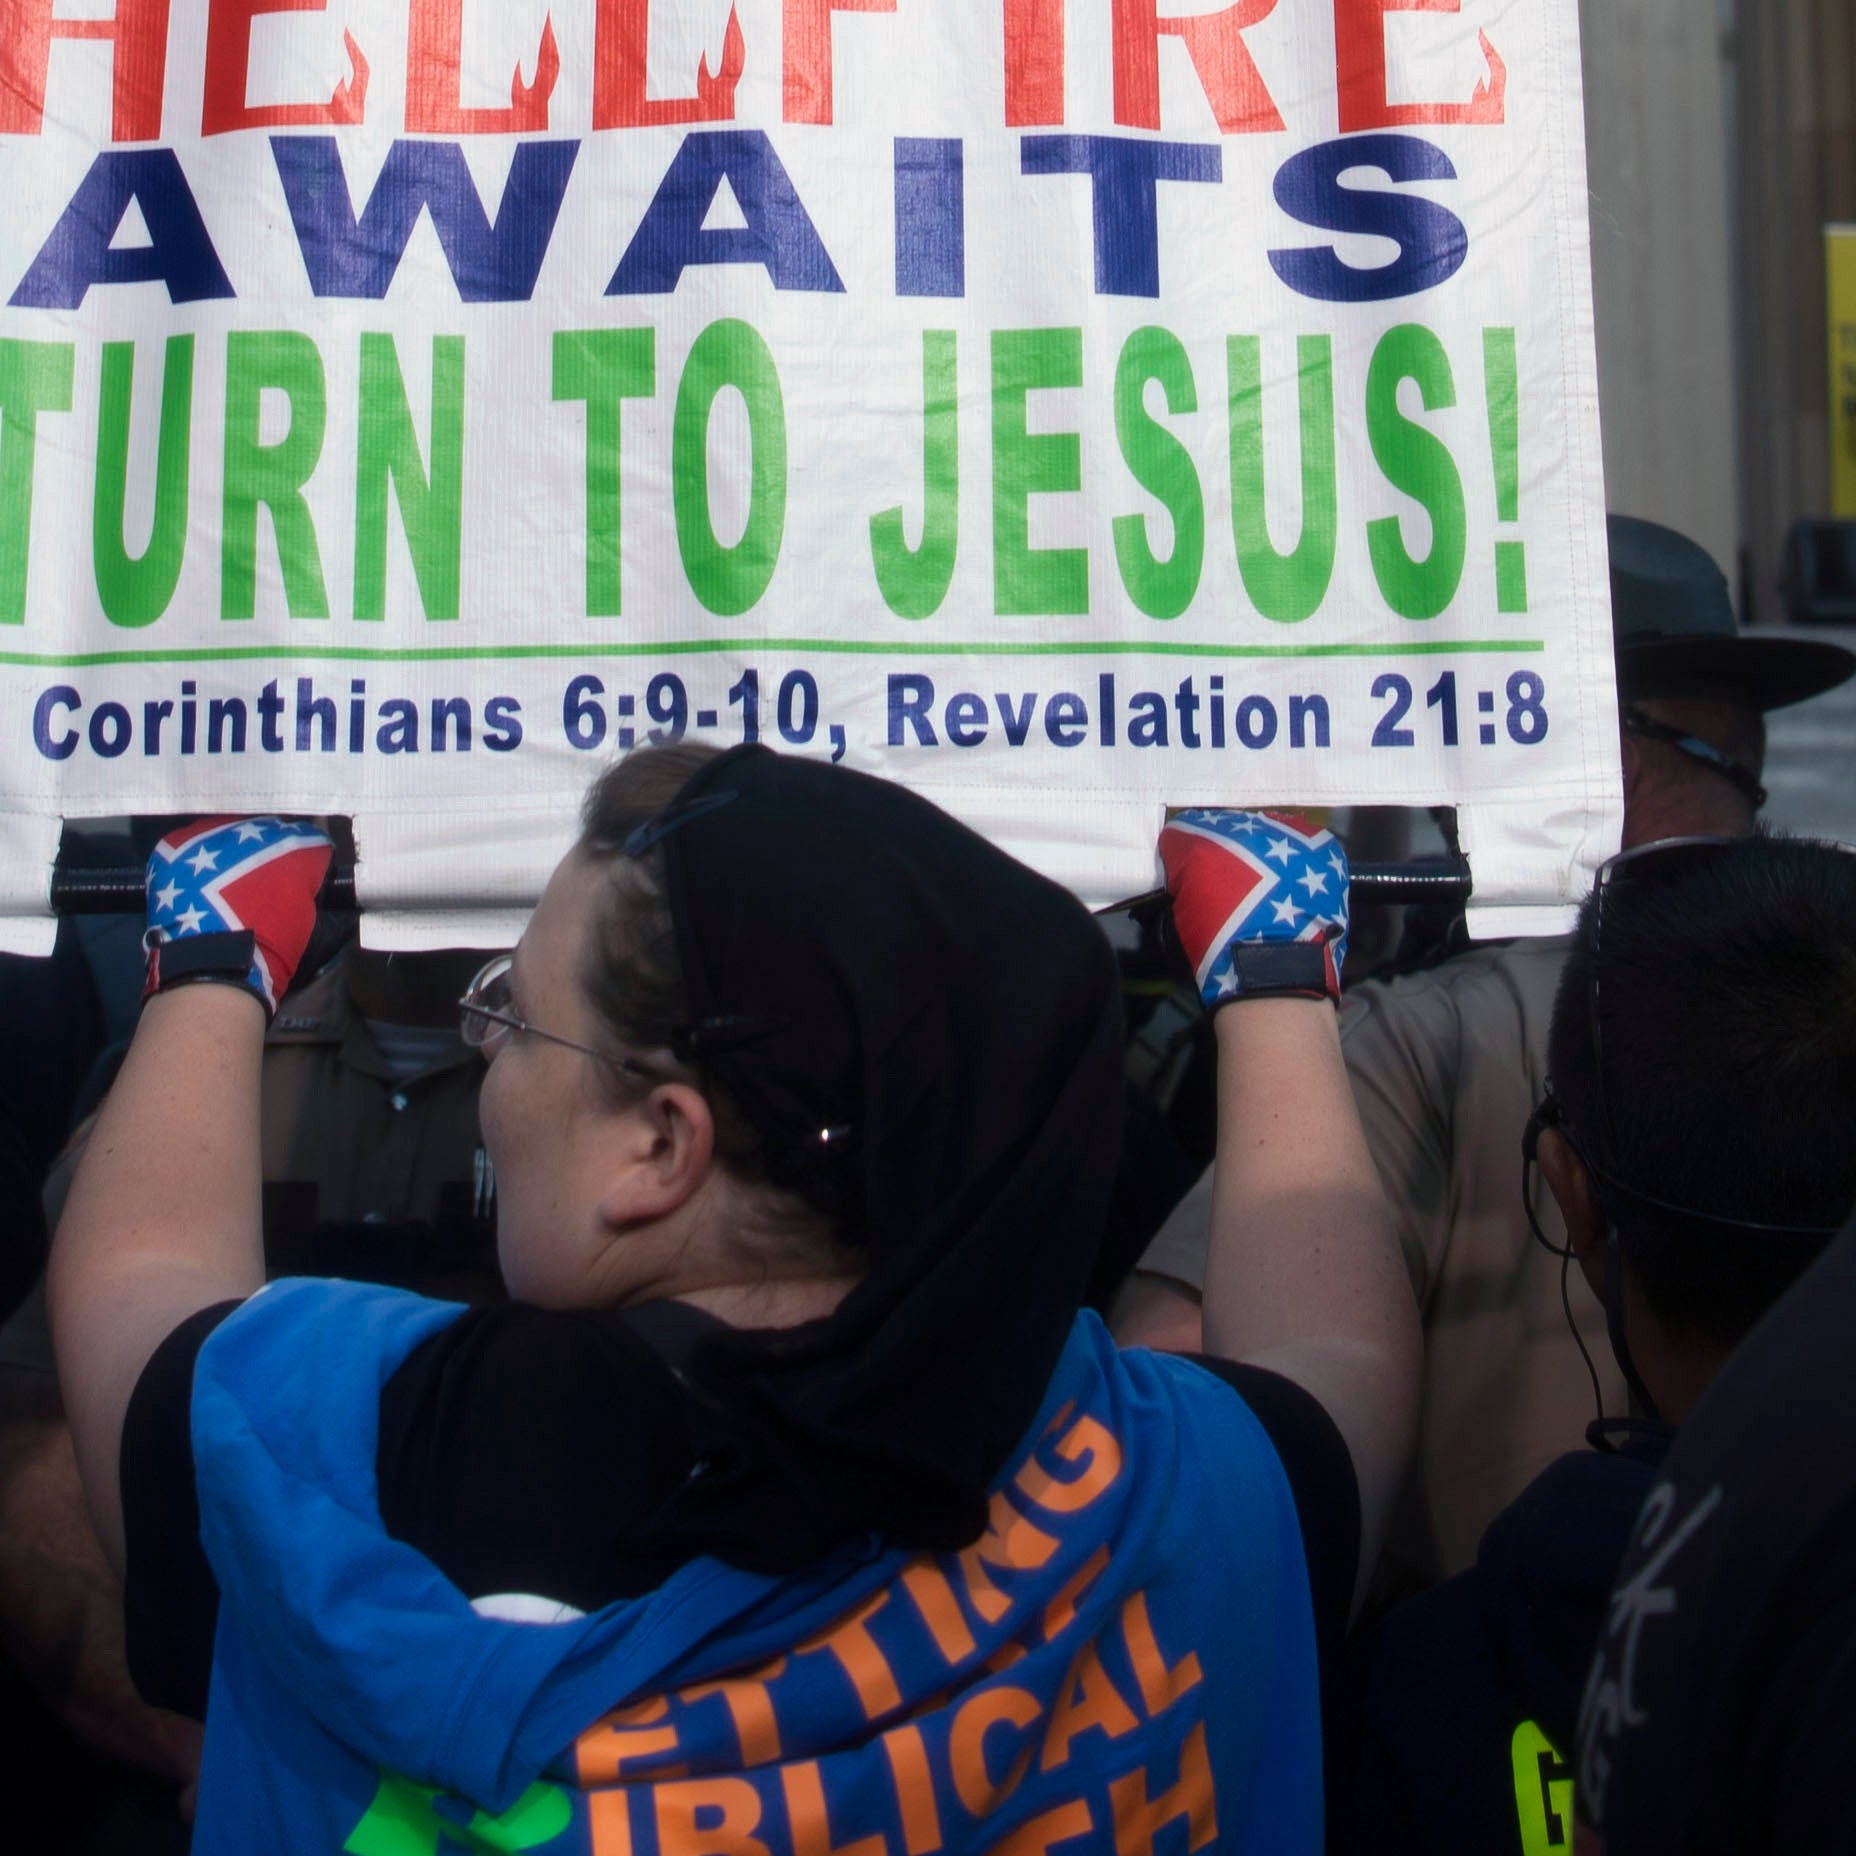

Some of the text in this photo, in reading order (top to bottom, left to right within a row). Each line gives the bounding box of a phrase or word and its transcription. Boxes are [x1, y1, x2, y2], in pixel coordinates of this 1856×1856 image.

[8, 128, 1470, 310] AWAITS
[551, 320, 786, 619] TO
[869, 324, 1528, 623] JESUS!
[33, 678, 523, 760] Corinthians
[562, 669, 847, 763] 6:9-10,
[887, 672, 1331, 749] Revelation
[1371, 671, 1549, 747] 21:8
